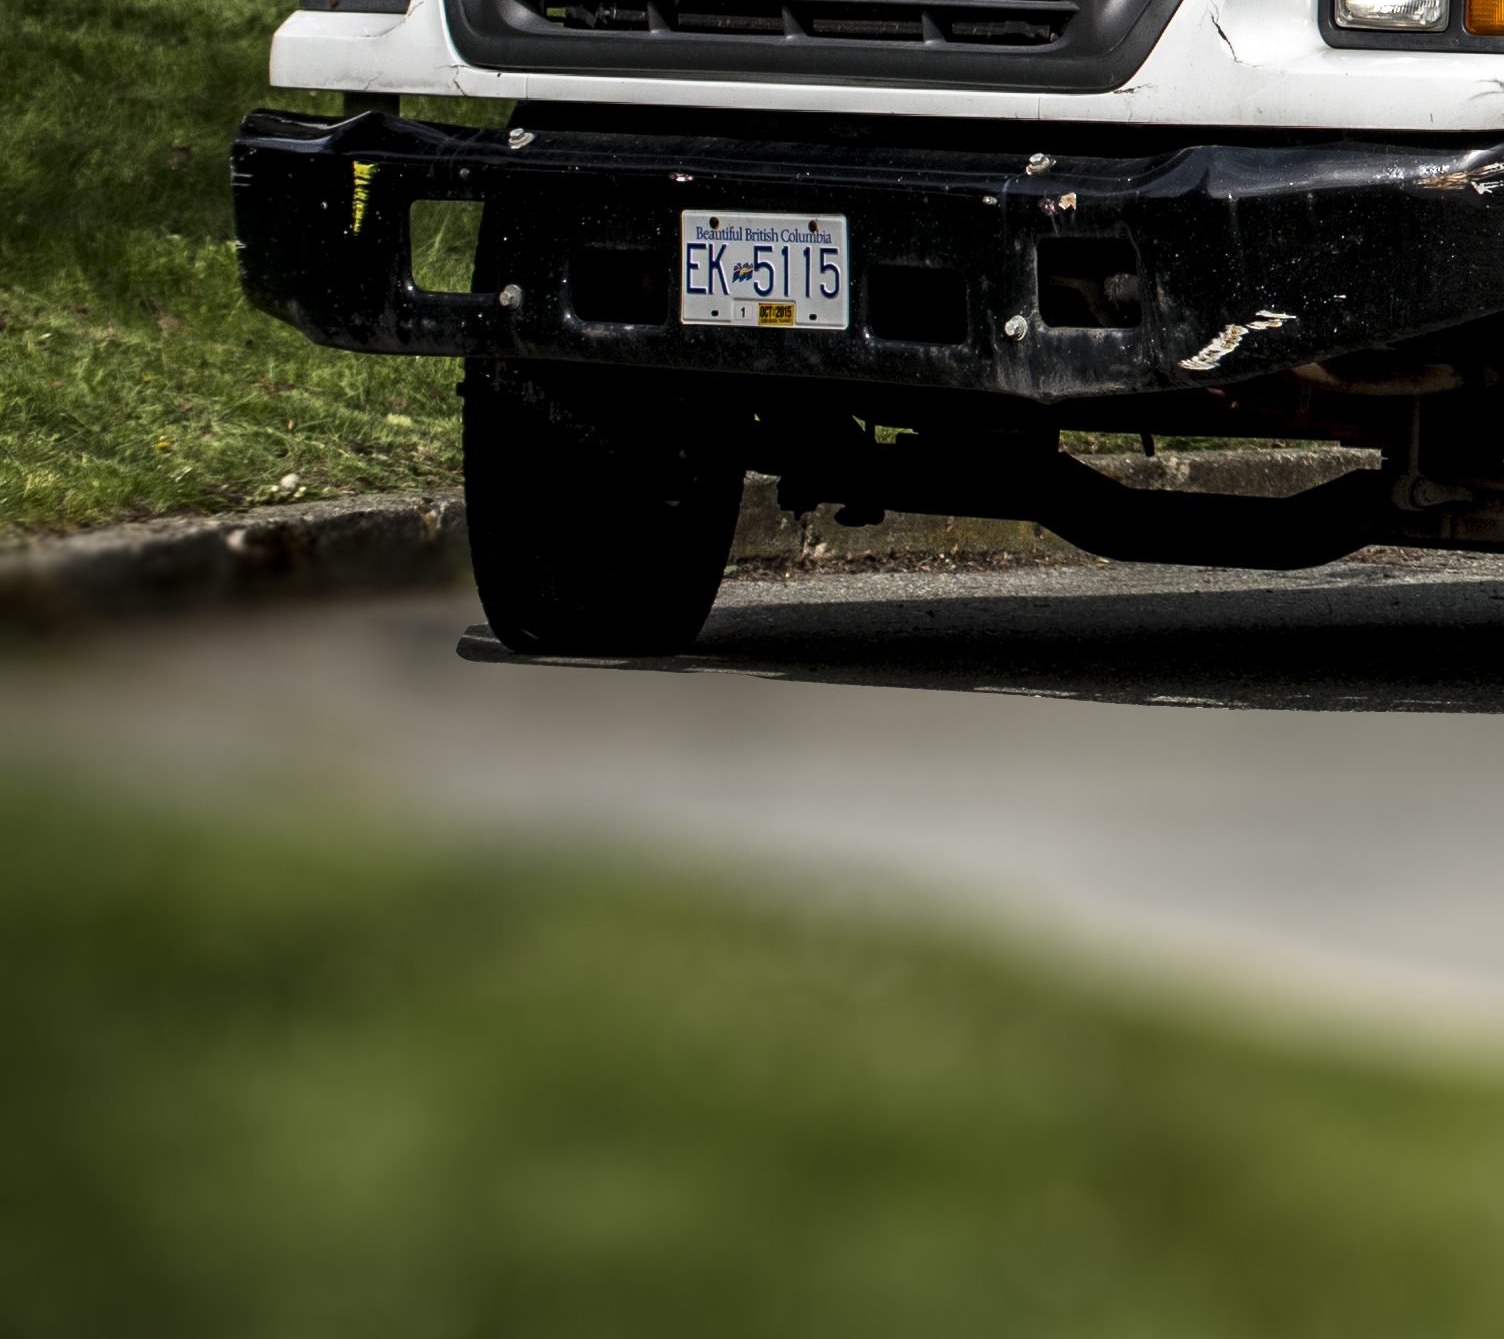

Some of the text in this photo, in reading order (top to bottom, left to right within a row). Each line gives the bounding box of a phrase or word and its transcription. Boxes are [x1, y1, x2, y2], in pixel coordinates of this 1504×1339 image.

[696, 226, 832, 245] Beautiful British Columbia
[686, 243, 841, 299] EK 5115
